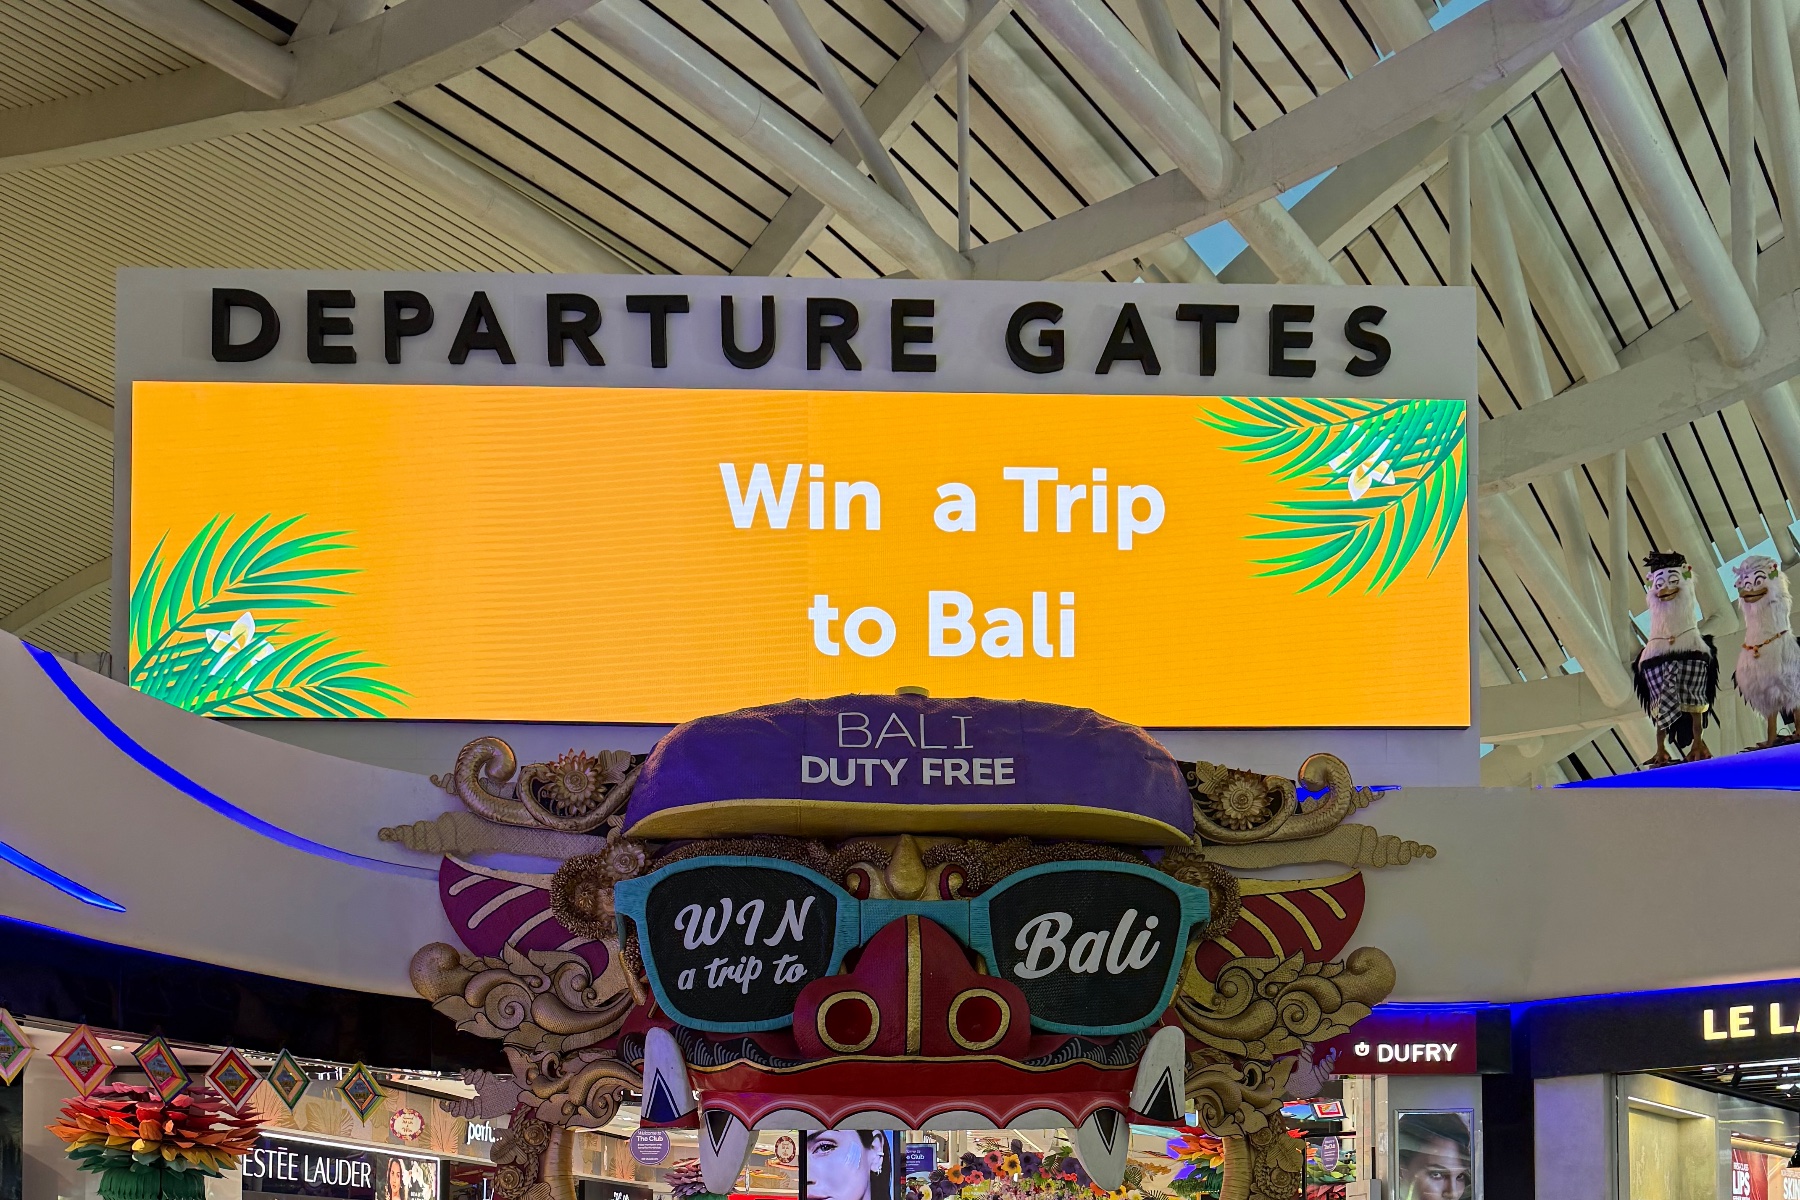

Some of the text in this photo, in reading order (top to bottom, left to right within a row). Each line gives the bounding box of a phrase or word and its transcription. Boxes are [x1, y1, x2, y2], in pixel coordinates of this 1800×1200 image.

[212, 288, 1391, 377] DEPARTURE GATES
[719, 463, 1165, 550] Win a Trip
[808, 590, 1075, 658] to Bali
[837, 711, 974, 750] BALI
[801, 755, 1016, 787] DUTY FREE
[674, 896, 816, 950] WIN
[1013, 908, 1161, 980] Bali
[677, 954, 808, 995] a trip to
[1703, 1003, 1800, 1040] LE L
[1378, 1043, 1458, 1062] DUFRY
[304, 1154, 372, 1188] LAUDER
